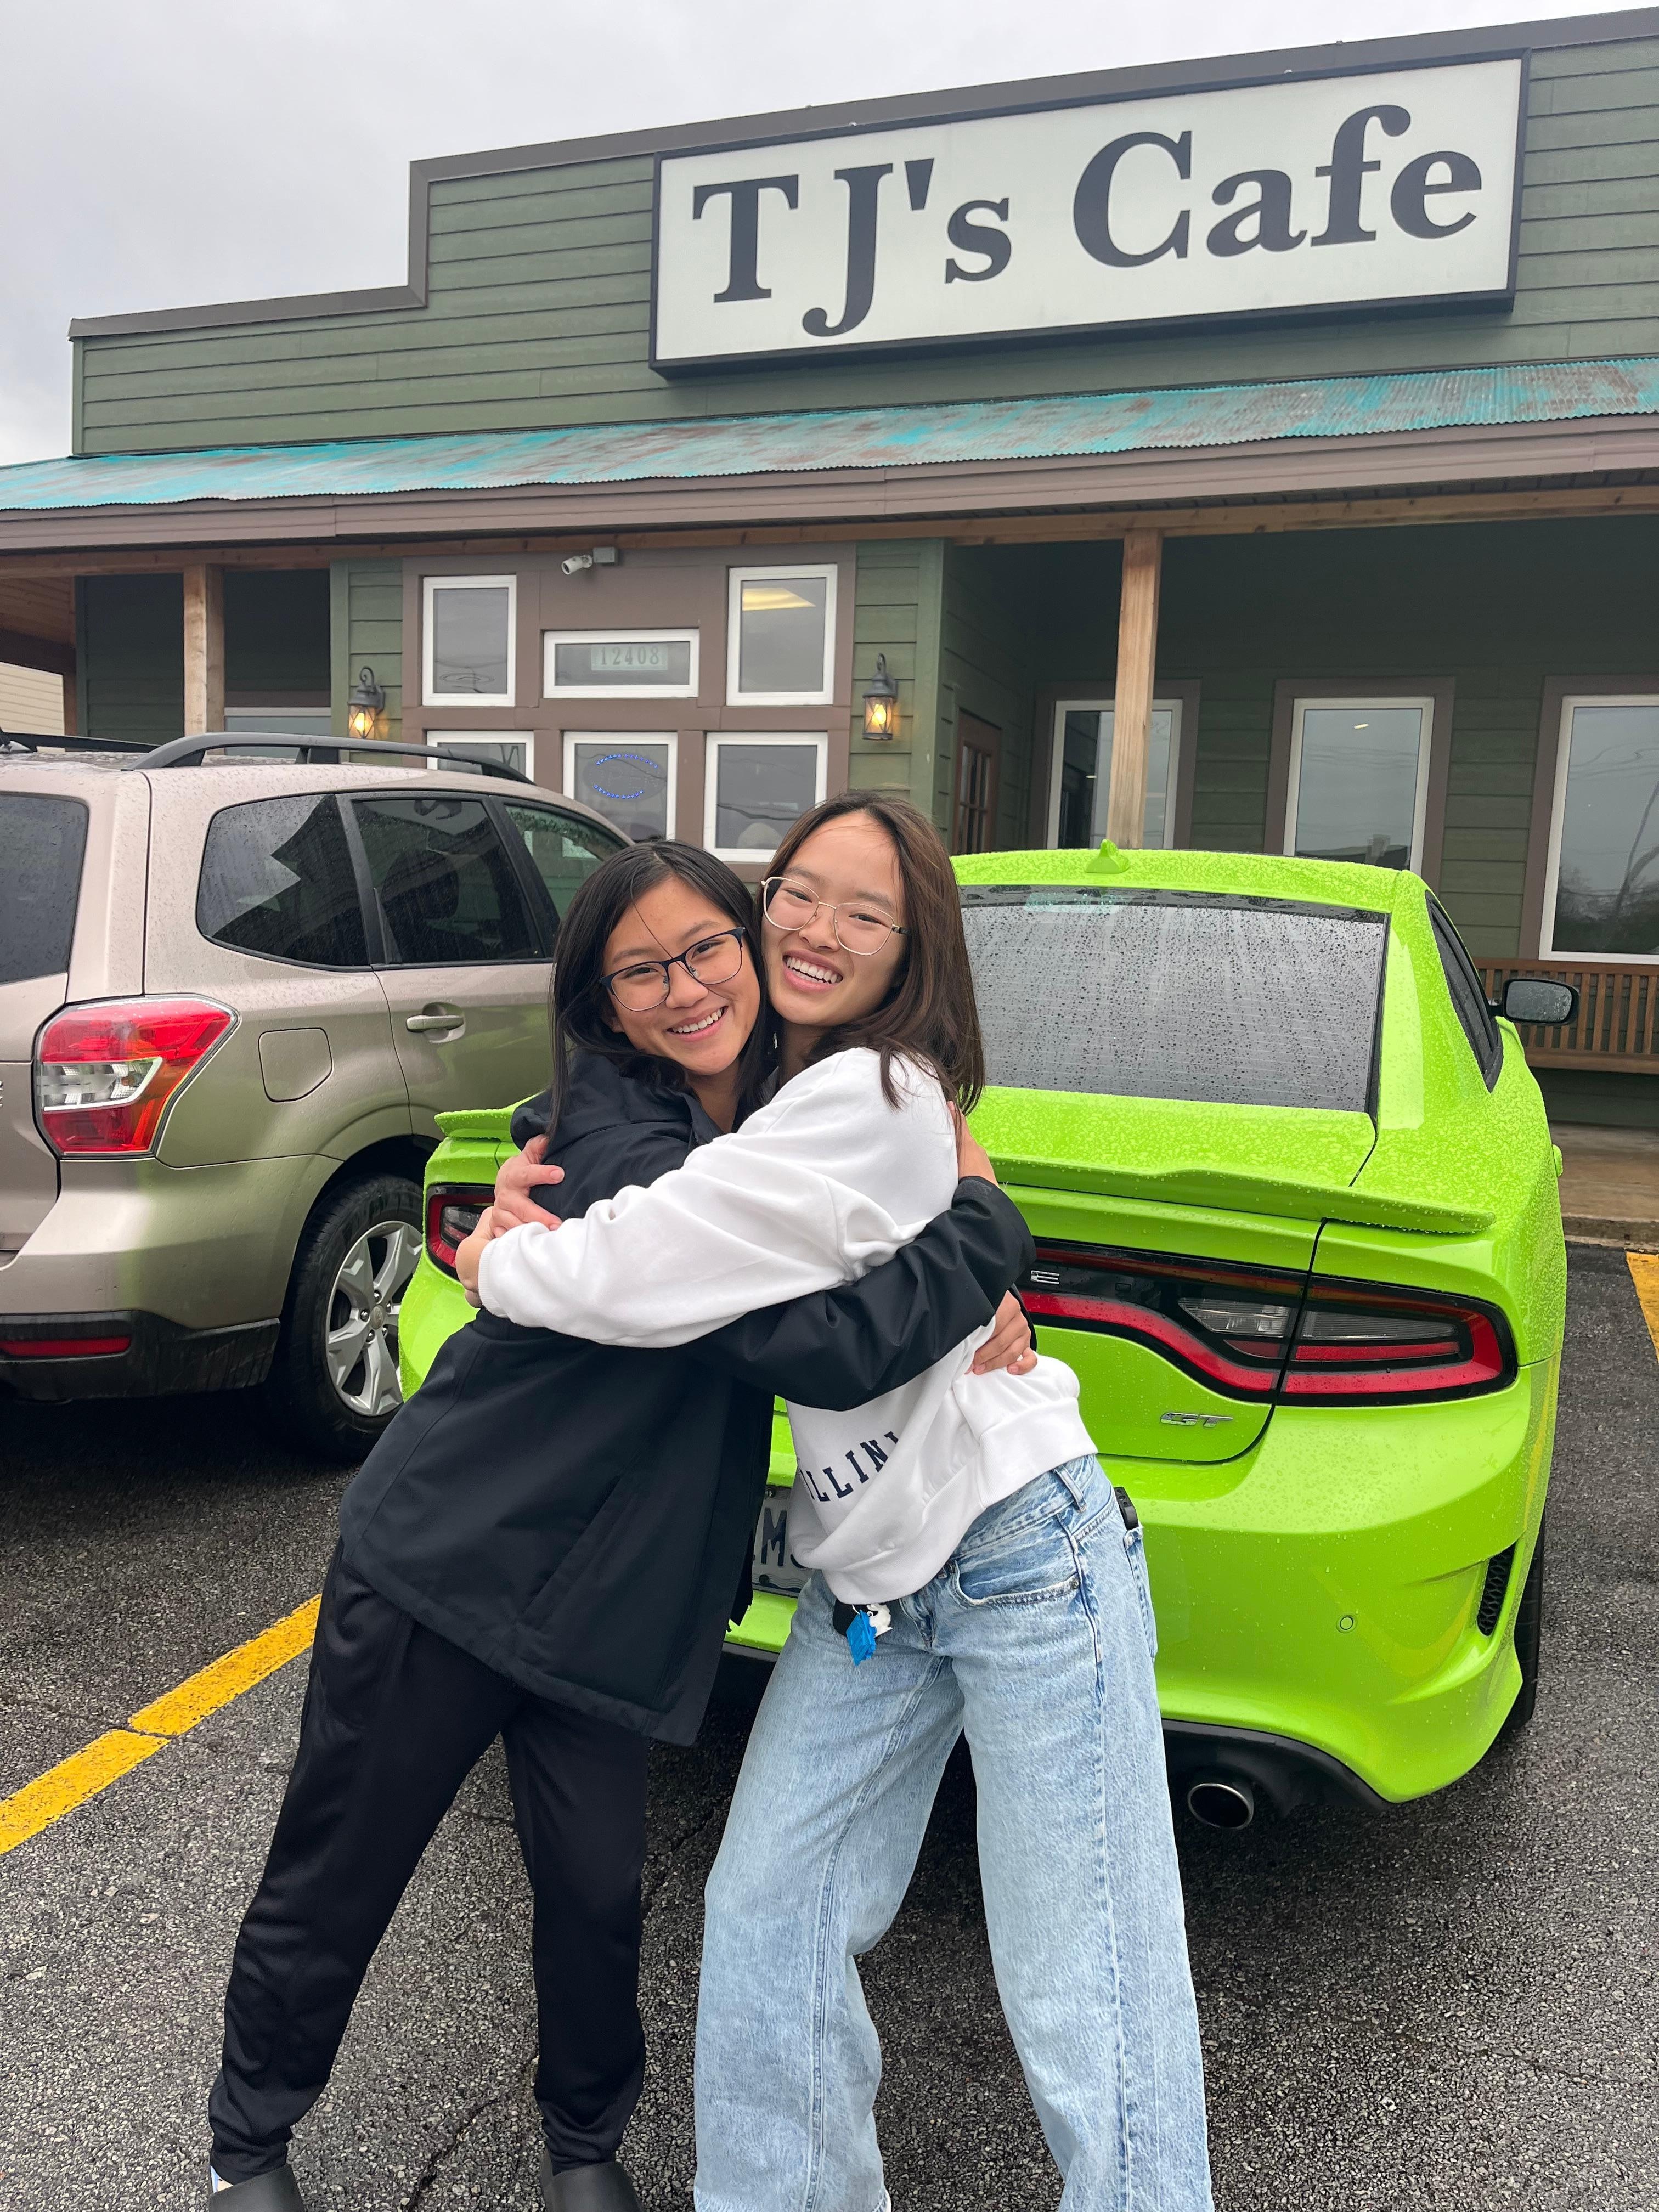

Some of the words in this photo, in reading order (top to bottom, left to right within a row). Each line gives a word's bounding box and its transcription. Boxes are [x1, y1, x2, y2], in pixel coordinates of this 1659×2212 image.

[693, 158, 1011, 336] TJ's
[1074, 105, 1481, 267] Cafe
[601, 646, 659, 665] 12408
[1160, 1412, 1233, 1427] GT
